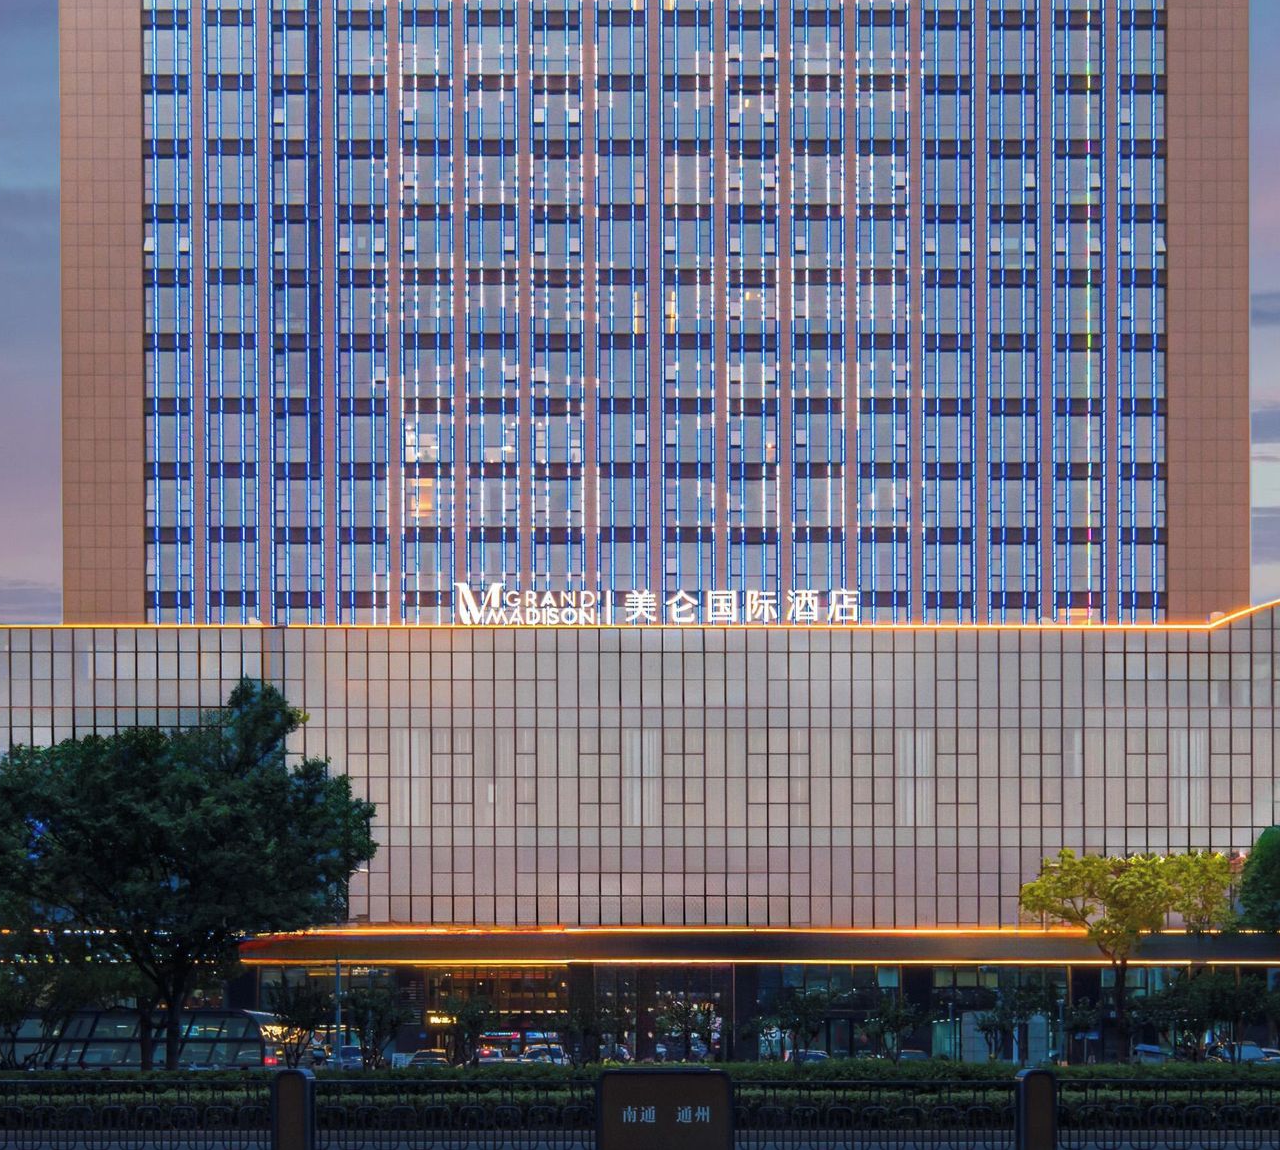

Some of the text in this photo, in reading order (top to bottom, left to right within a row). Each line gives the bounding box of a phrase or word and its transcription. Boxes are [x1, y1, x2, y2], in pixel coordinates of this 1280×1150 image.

[506, 590, 597, 607] GRAND
[625, 588, 860, 622] 美仑国际酒店
[485, 607, 597, 625] MADISON
[622, 1105, 710, 1123] 南通 通州
